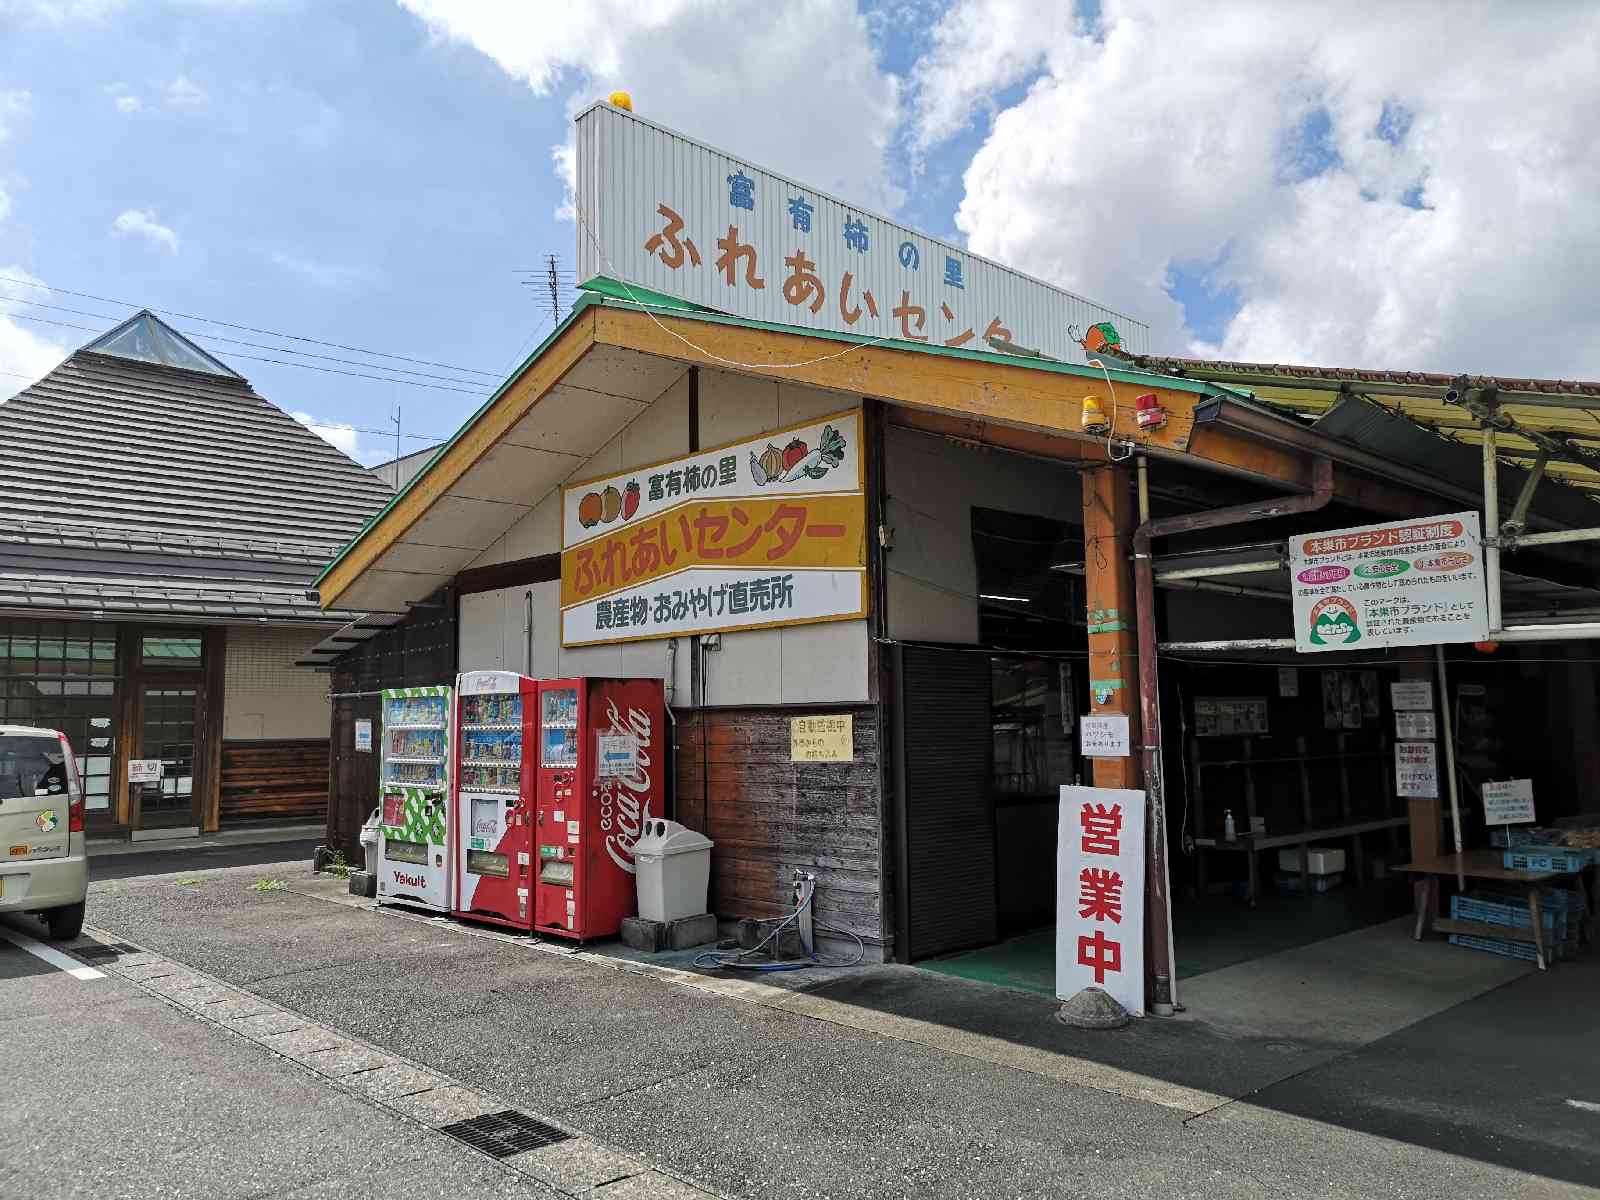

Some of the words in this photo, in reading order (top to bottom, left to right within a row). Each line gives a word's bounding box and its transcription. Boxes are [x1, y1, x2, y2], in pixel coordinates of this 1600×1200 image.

[726, 169, 965, 289] 富有柿の里
[648, 455, 737, 502] 富有柿の里
[574, 503, 846, 595] ふれあいセンター
[595, 573, 793, 631] 農産物・おみやげ直売所
[393, 871, 427, 889] Yakult
[1077, 803, 1123, 984] 営業中
